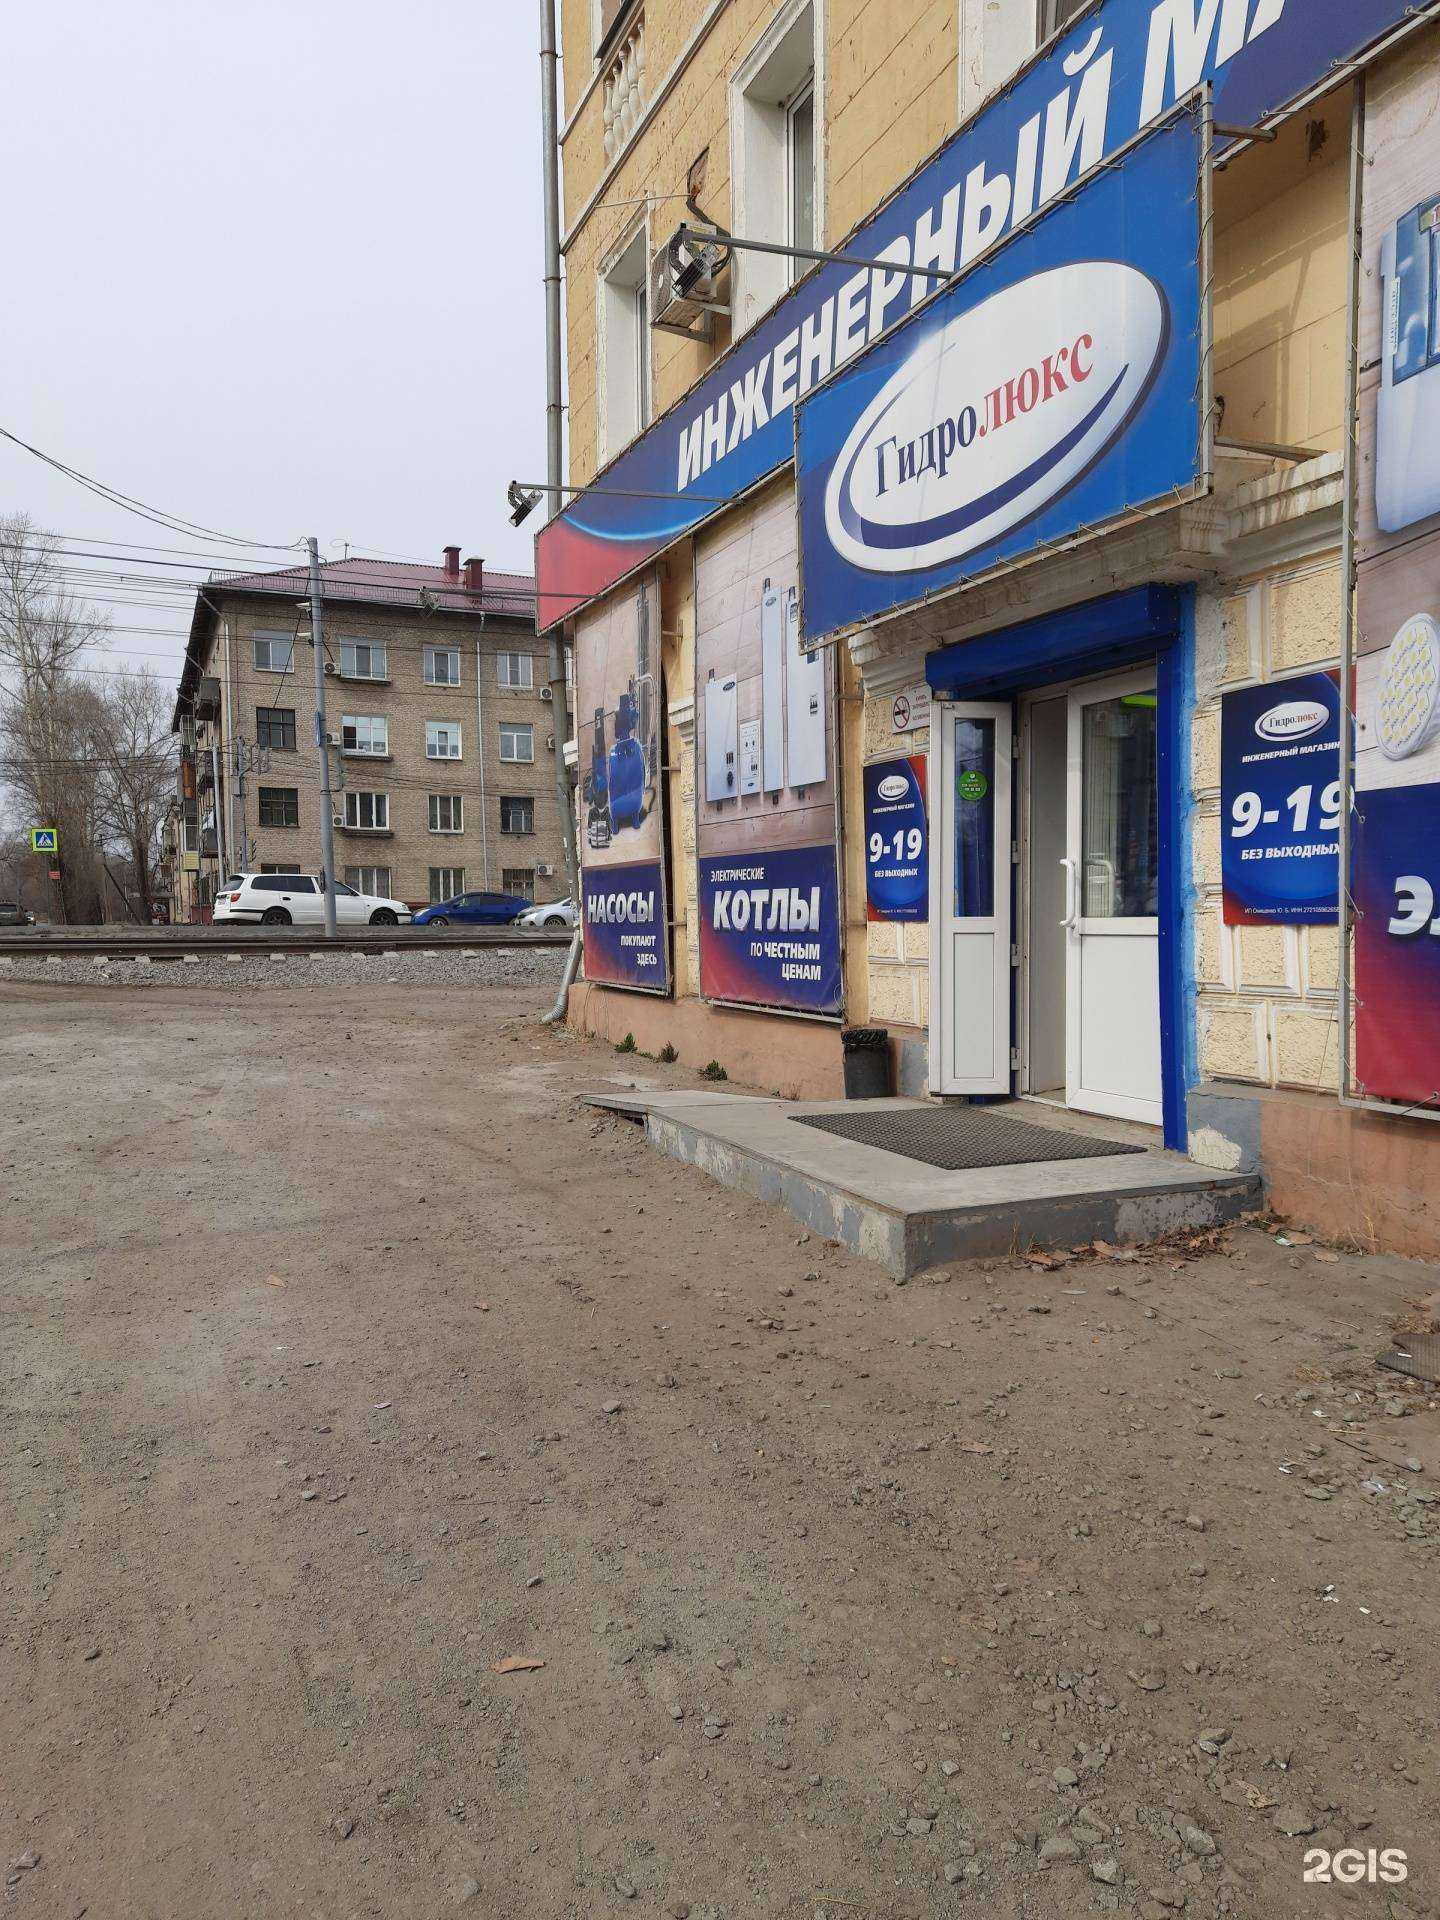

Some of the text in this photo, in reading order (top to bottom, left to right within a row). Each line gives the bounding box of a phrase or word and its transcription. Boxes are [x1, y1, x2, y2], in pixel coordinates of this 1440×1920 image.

[677, 0, 1287, 493] ИНЖЕНЕРНЫЙ М
[1242, 741, 1341, 763] ИНЖЕНЕРНЫЙ МАГАЗИН
[1231, 780, 1355, 838] 9-19
[869, 828, 922, 863] 9-19
[1241, 843, 1341, 860] БЕЗ ВЫХОДНЫХ
[710, 867, 765, 882] ЭЛЕКТРИЧЕСКИЕ
[885, 868, 918, 878] ВЫХОДНЫХ
[587, 891, 655, 923] НАСОСЫ
[713, 886, 821, 932] КОТЛЫ
[1387, 875, 1440, 936] Э
[620, 935, 657, 946] ПОКУПАЮТ
[750, 941, 821, 960] ПО ЧЕСТНЫМ
[636, 953, 658, 967] ЗДЕСЬ
[781, 963, 822, 981] ЦЕНАМ
